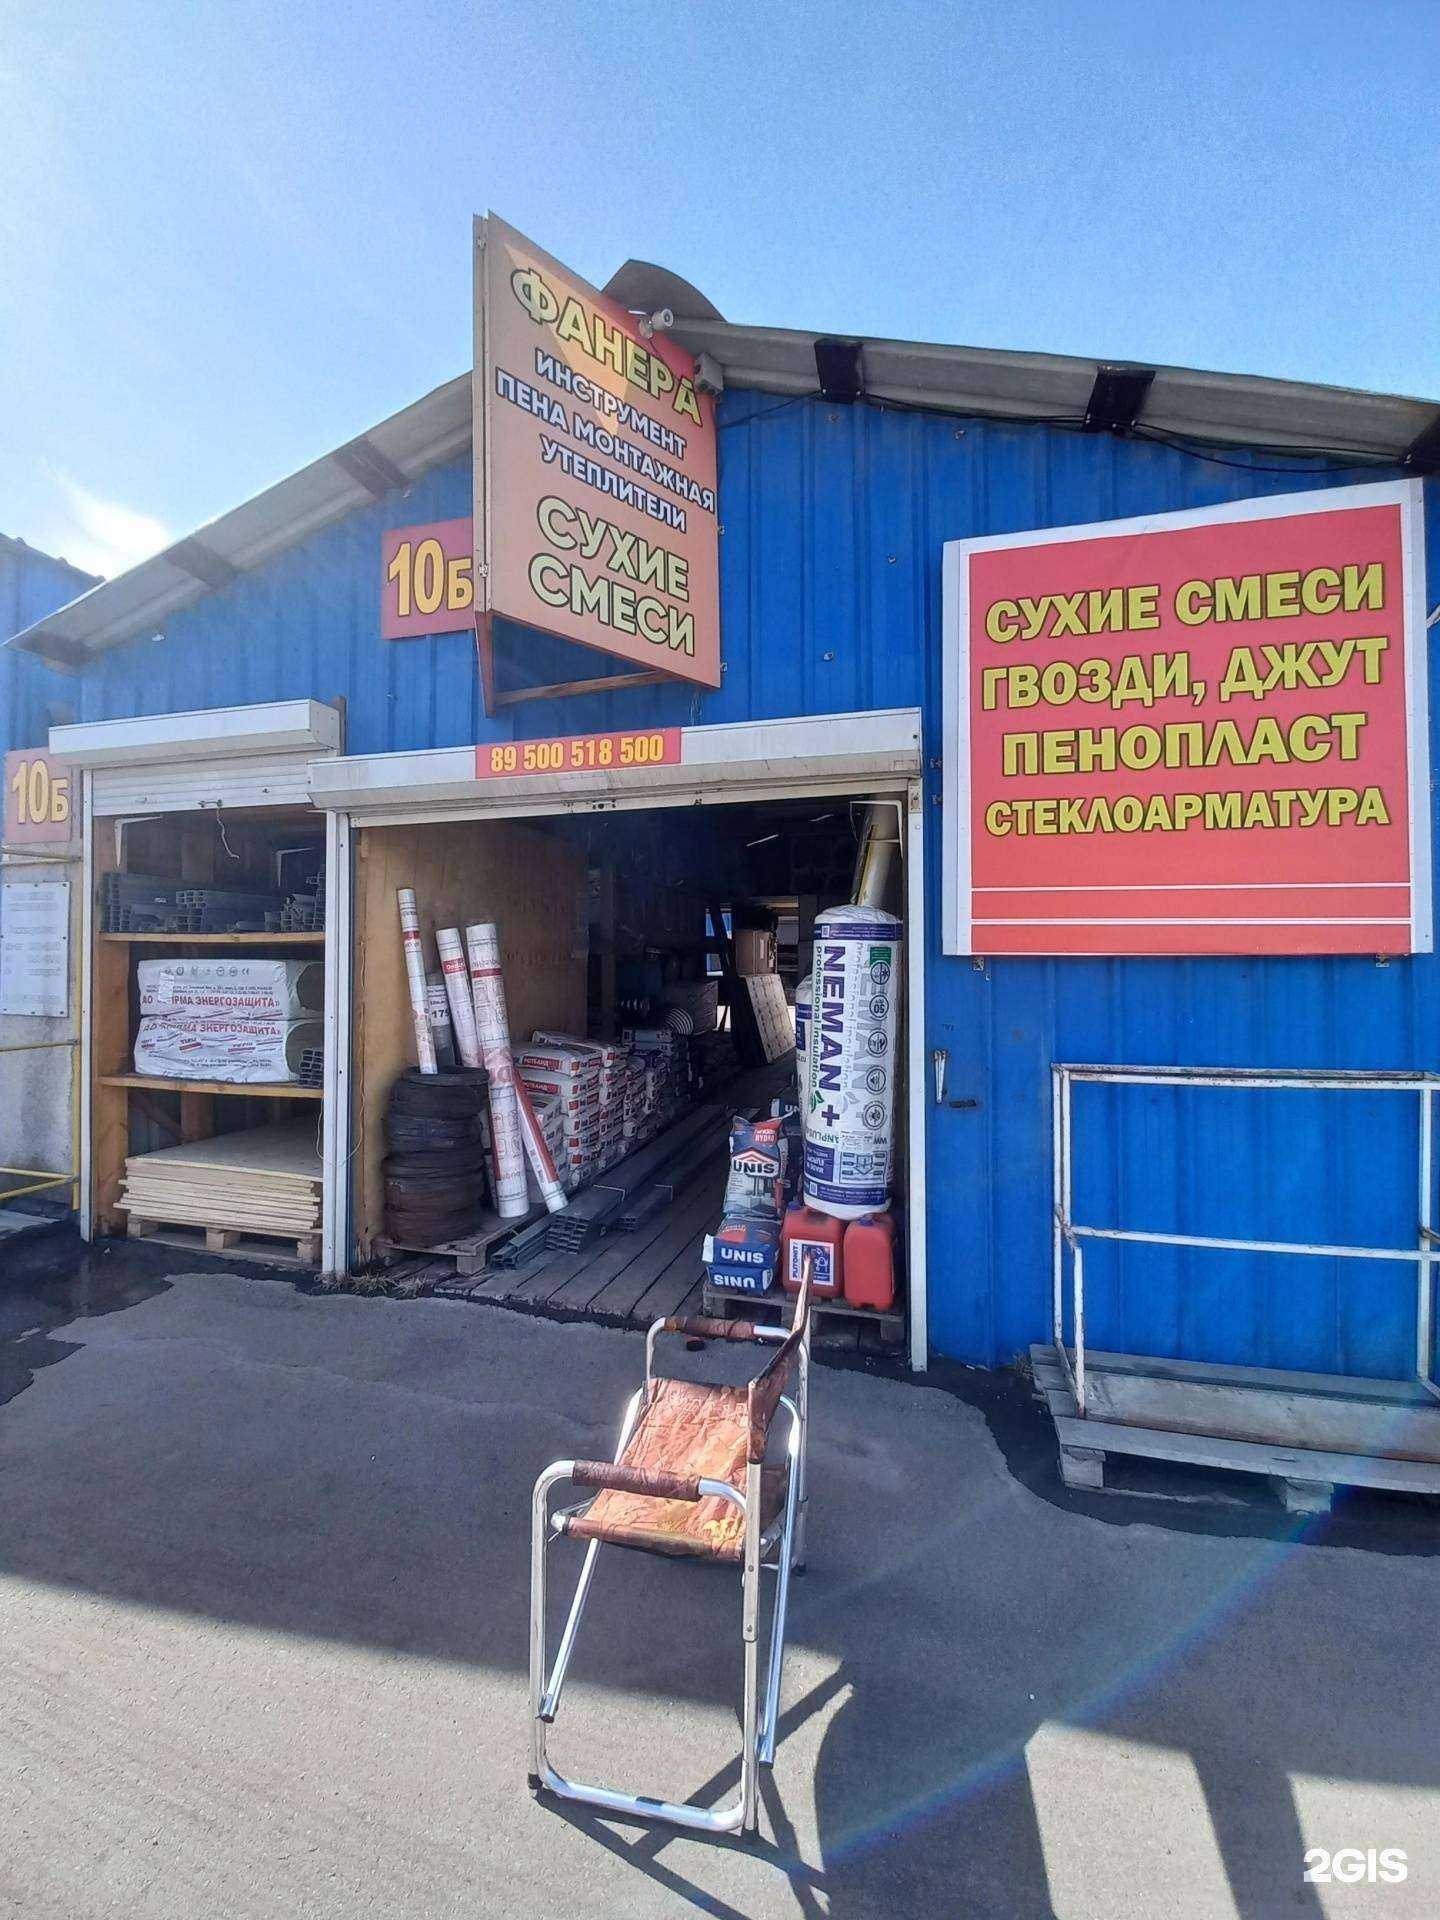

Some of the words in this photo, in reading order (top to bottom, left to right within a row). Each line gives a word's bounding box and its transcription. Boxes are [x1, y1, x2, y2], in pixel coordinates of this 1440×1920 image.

[510, 267, 703, 426] ФАНЕРА
[495, 366, 569, 433] ПЕНА
[573, 412, 717, 514] МОНТАЖНАЯ
[534, 347, 688, 461] ИНСТРУМЕНТ
[539, 434, 688, 534] УТЕПЛИТЕЛИ
[386, 537, 473, 618] 10Б
[536, 494, 690, 604] СУХИЕ
[527, 552, 696, 657] СМЕСИ
[985, 583, 1162, 644] СУХИЕ
[1174, 562, 1385, 627] СМЕСИ
[981, 651, 1208, 711] ГВОЗДИ,
[1218, 635, 1390, 701] ДЖУТ
[490, 745, 517, 773] 89
[523, 741, 564, 770] 500
[570, 738, 613, 768] 518
[620, 733, 664, 764] 500
[1002, 712, 1368, 777] ПЕНОПЛАСТ
[11, 759, 71, 824] 10Б
[984, 785, 1391, 837] СТЕКЛОАРМАТУРА
[818, 945, 846, 1092] NEMAN
[734, 1160, 775, 1174] UNIS
[713, 1274, 755, 1288] UNIS
[721, 1247, 764, 1264] UNIS
